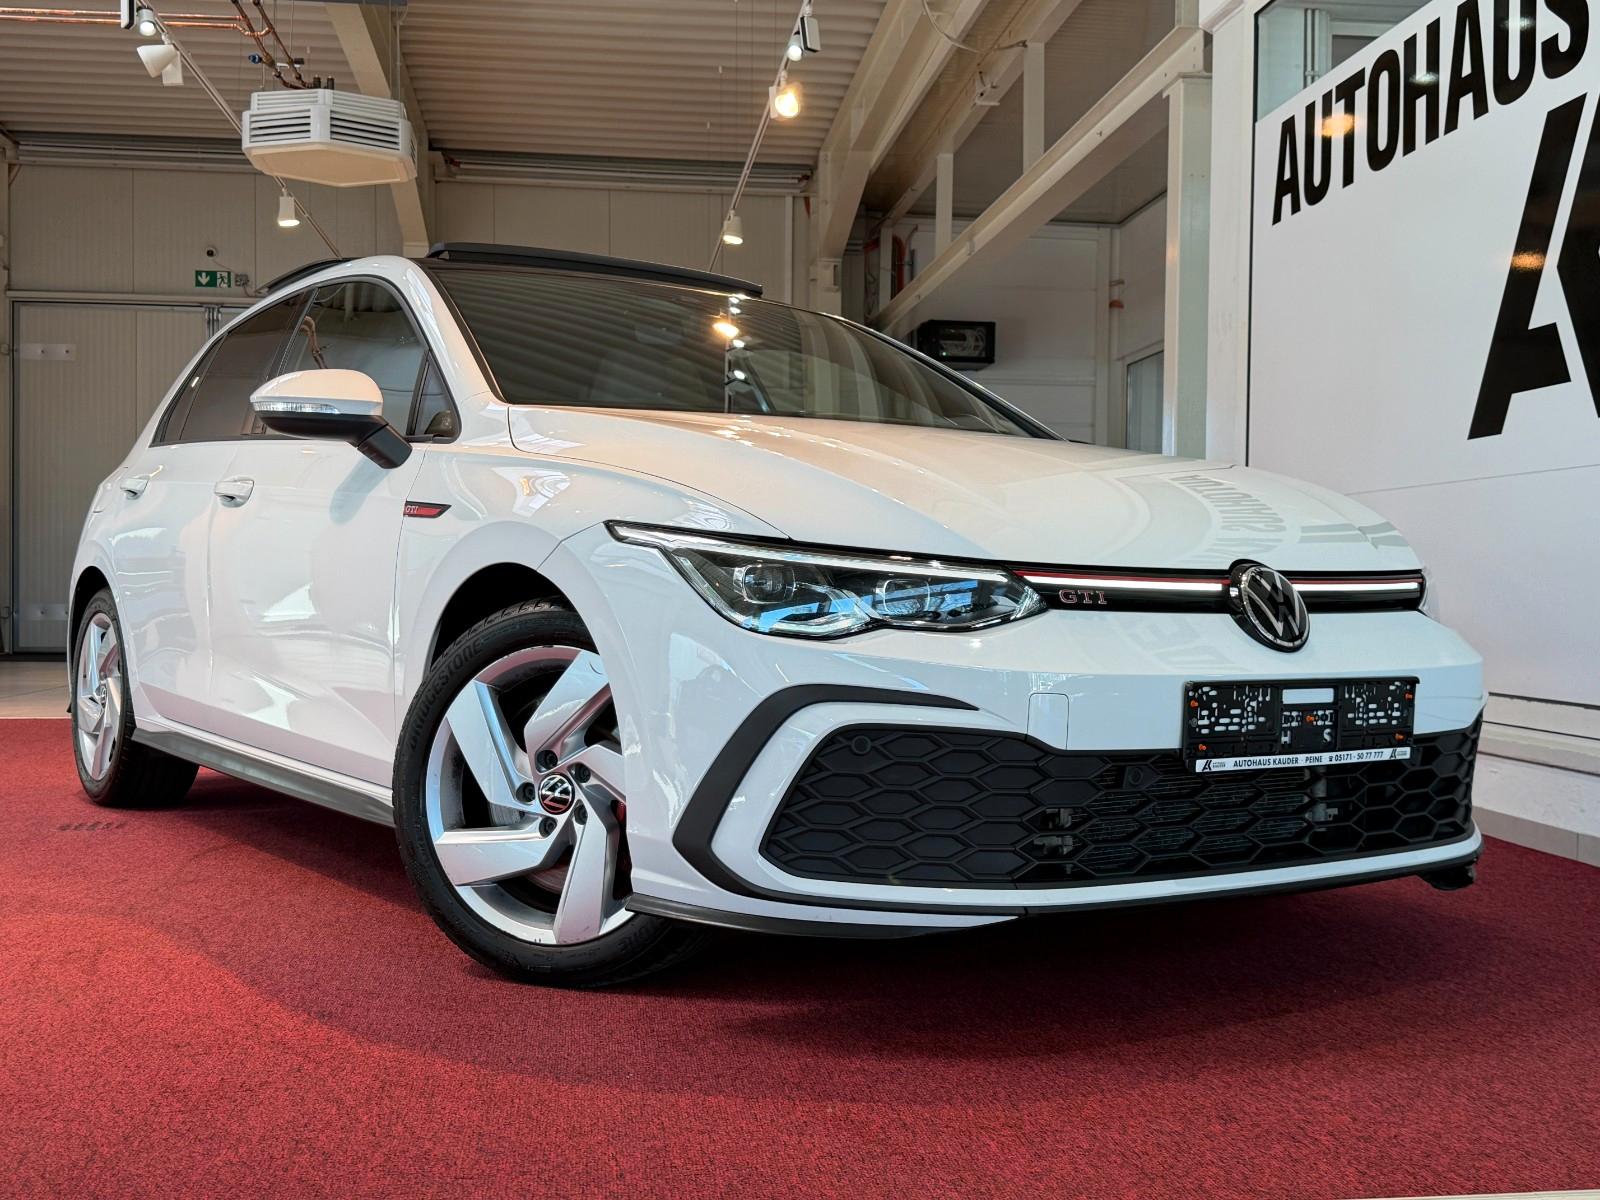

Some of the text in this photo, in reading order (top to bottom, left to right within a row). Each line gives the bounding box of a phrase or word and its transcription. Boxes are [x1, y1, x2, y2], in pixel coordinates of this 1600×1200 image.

[1272, 0, 1590, 226] AUTOHAUS
[405, 505, 418, 513] GTI
[1059, 589, 1107, 605] GTI
[1233, 758, 1271, 768] AUTOHAUS
[1272, 756, 1299, 766] KAUDER
[1305, 755, 1323, 763] PEINE
[1335, 753, 1352, 762] 05171
